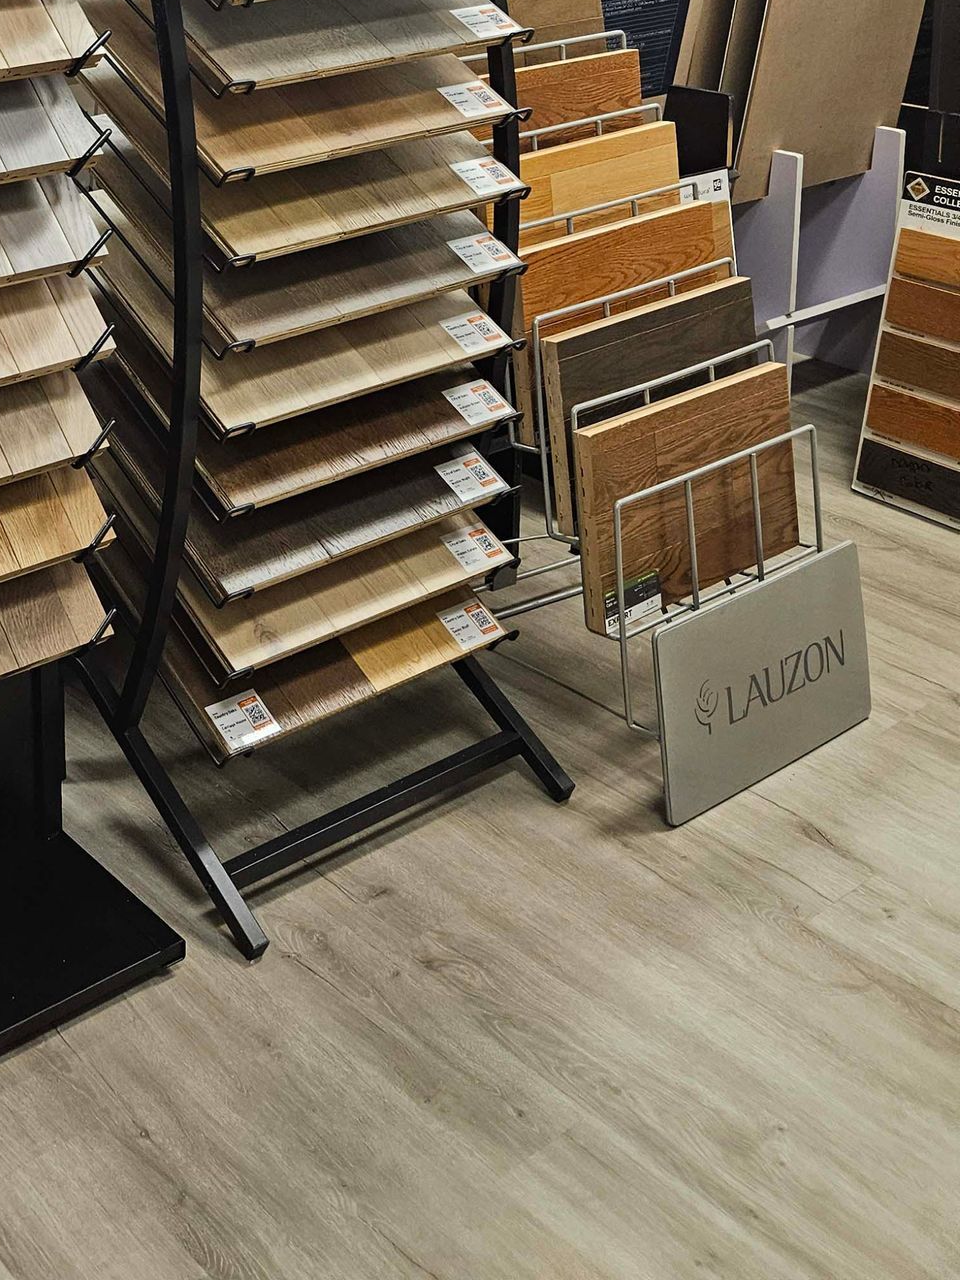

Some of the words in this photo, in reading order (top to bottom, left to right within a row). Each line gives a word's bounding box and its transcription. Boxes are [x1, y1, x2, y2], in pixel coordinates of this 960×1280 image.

[935, 185, 960, 198] ESSE
[908, 203, 951, 219] ESSENTIALS
[908, 210, 945, 224] Semi-Gloss
[725, 629, 846, 725] LAUZON
